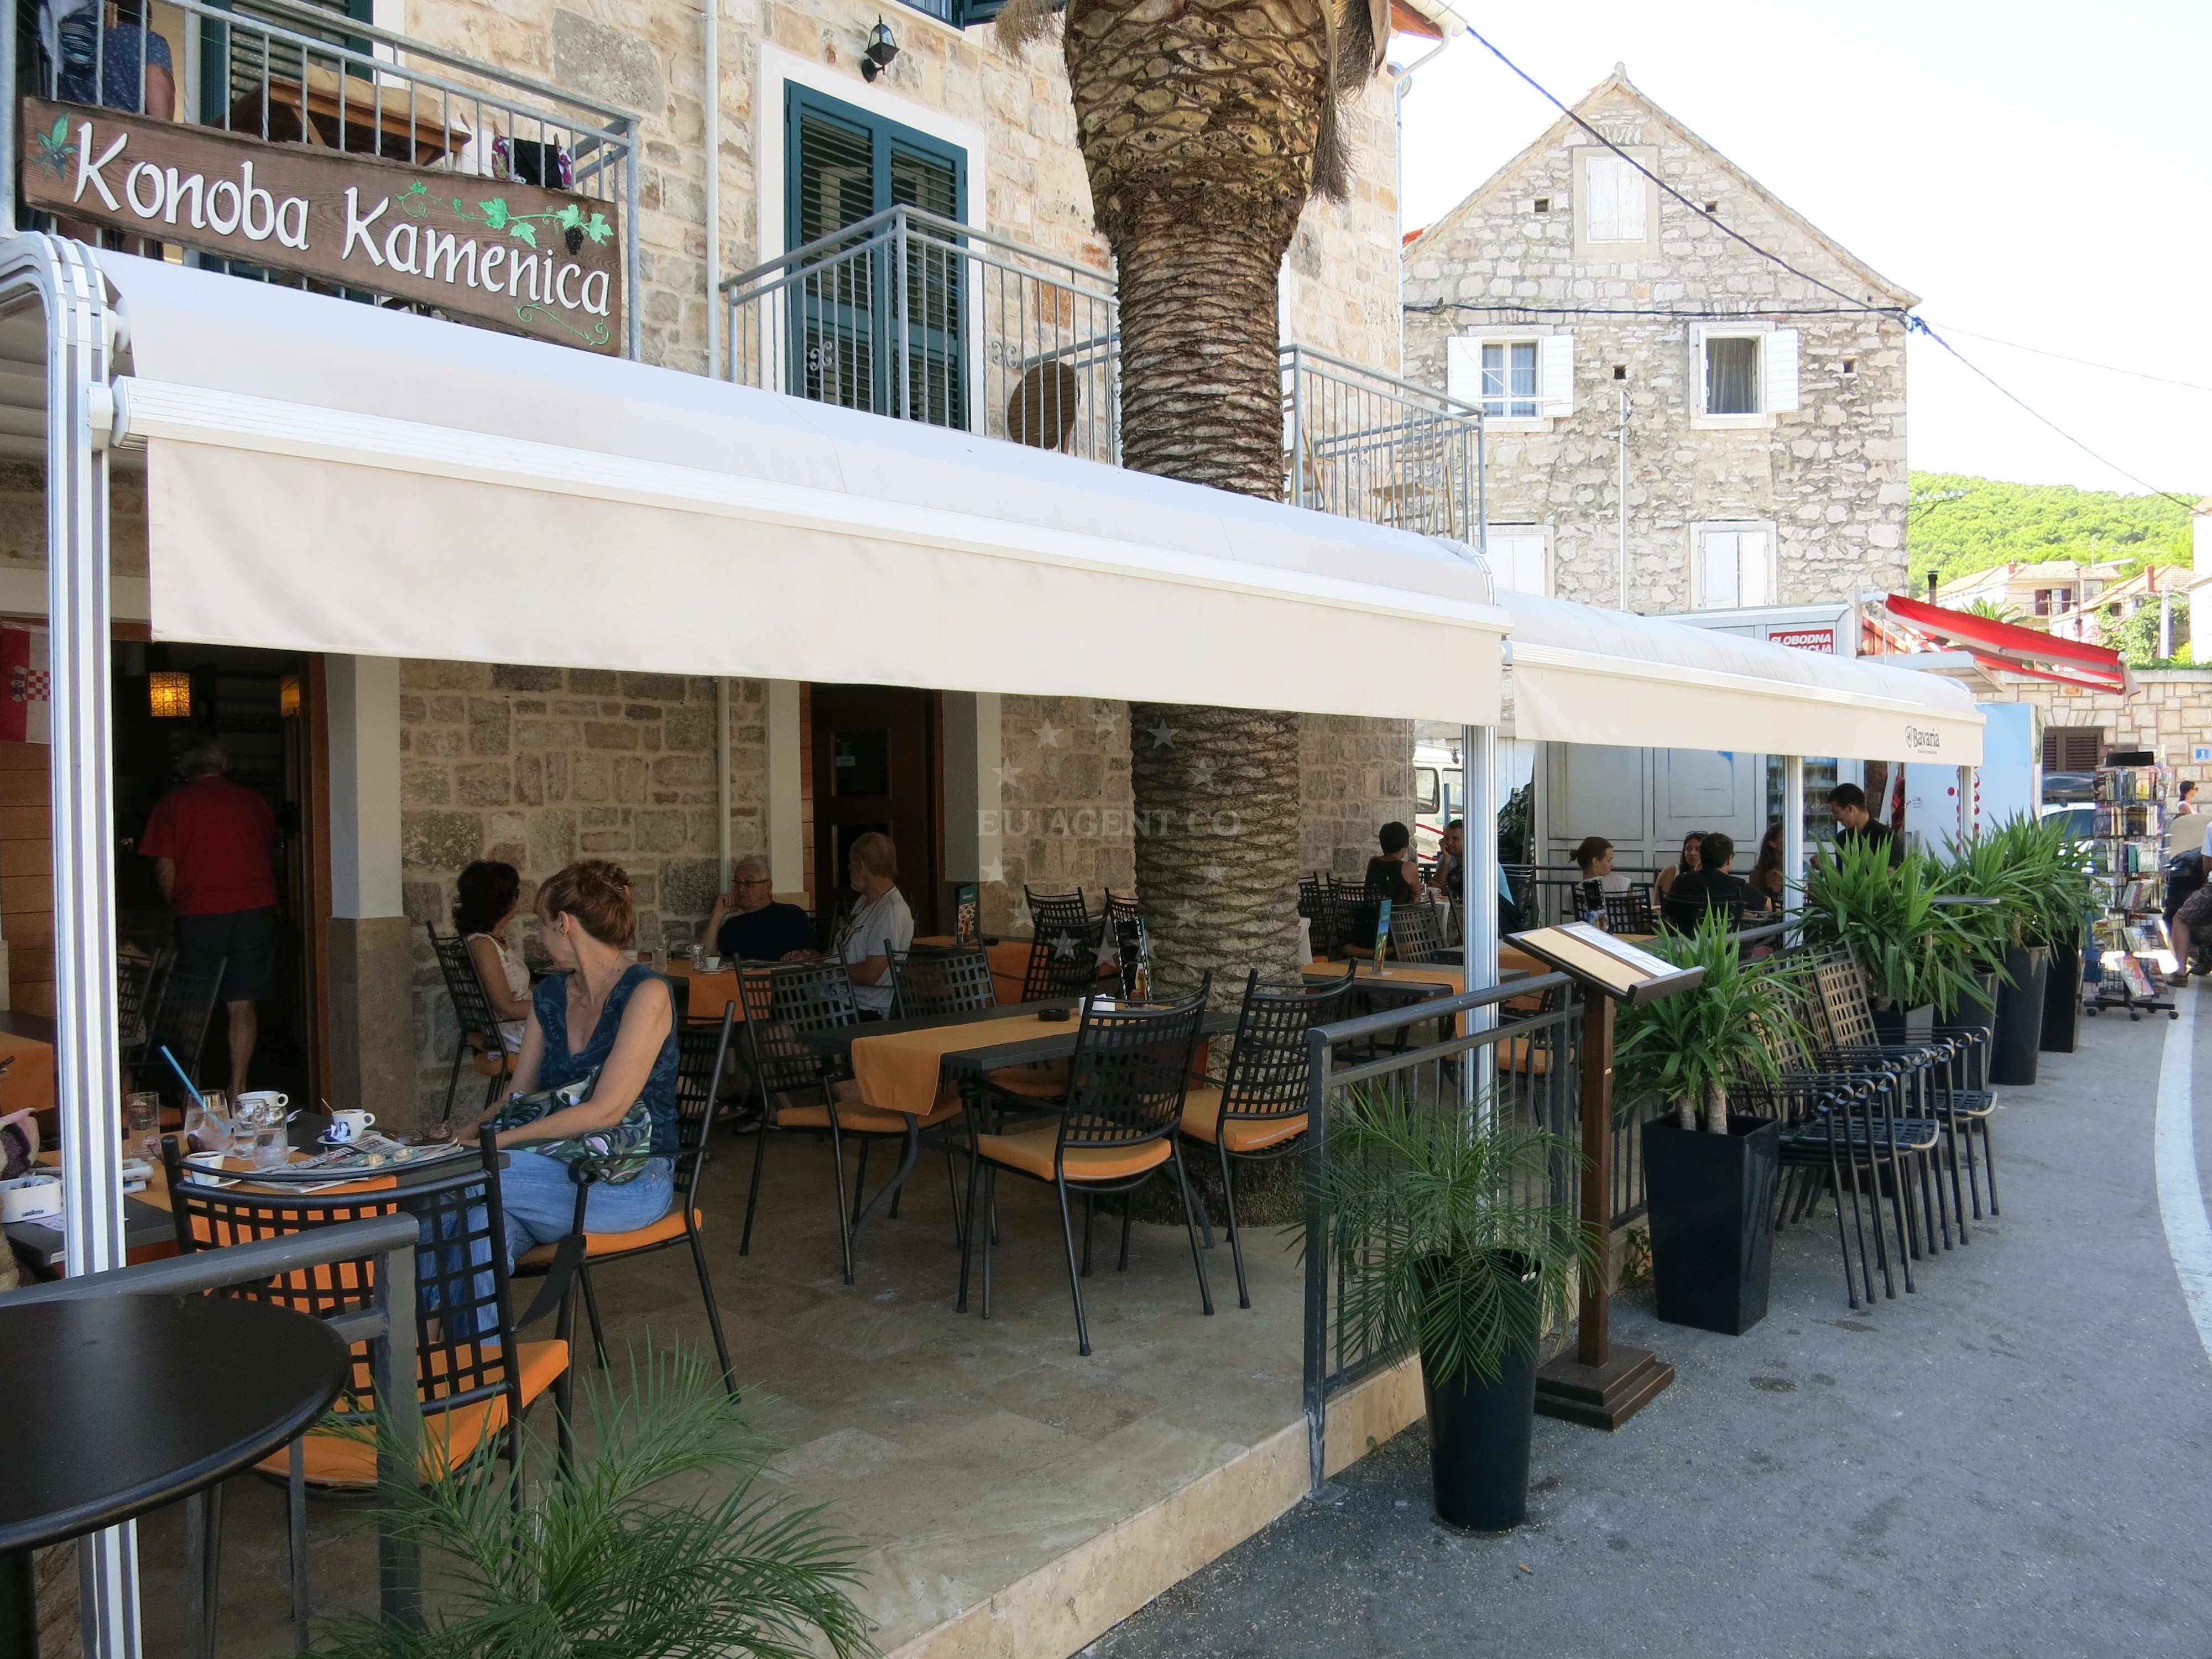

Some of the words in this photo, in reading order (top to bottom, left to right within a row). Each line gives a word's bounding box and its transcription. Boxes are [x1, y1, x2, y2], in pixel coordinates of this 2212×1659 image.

[73, 121, 310, 251] Konoba
[342, 186, 611, 317] Kamenica
[1912, 728, 1940, 747] Bavaria
[2199, 749, 2206, 759] 1
